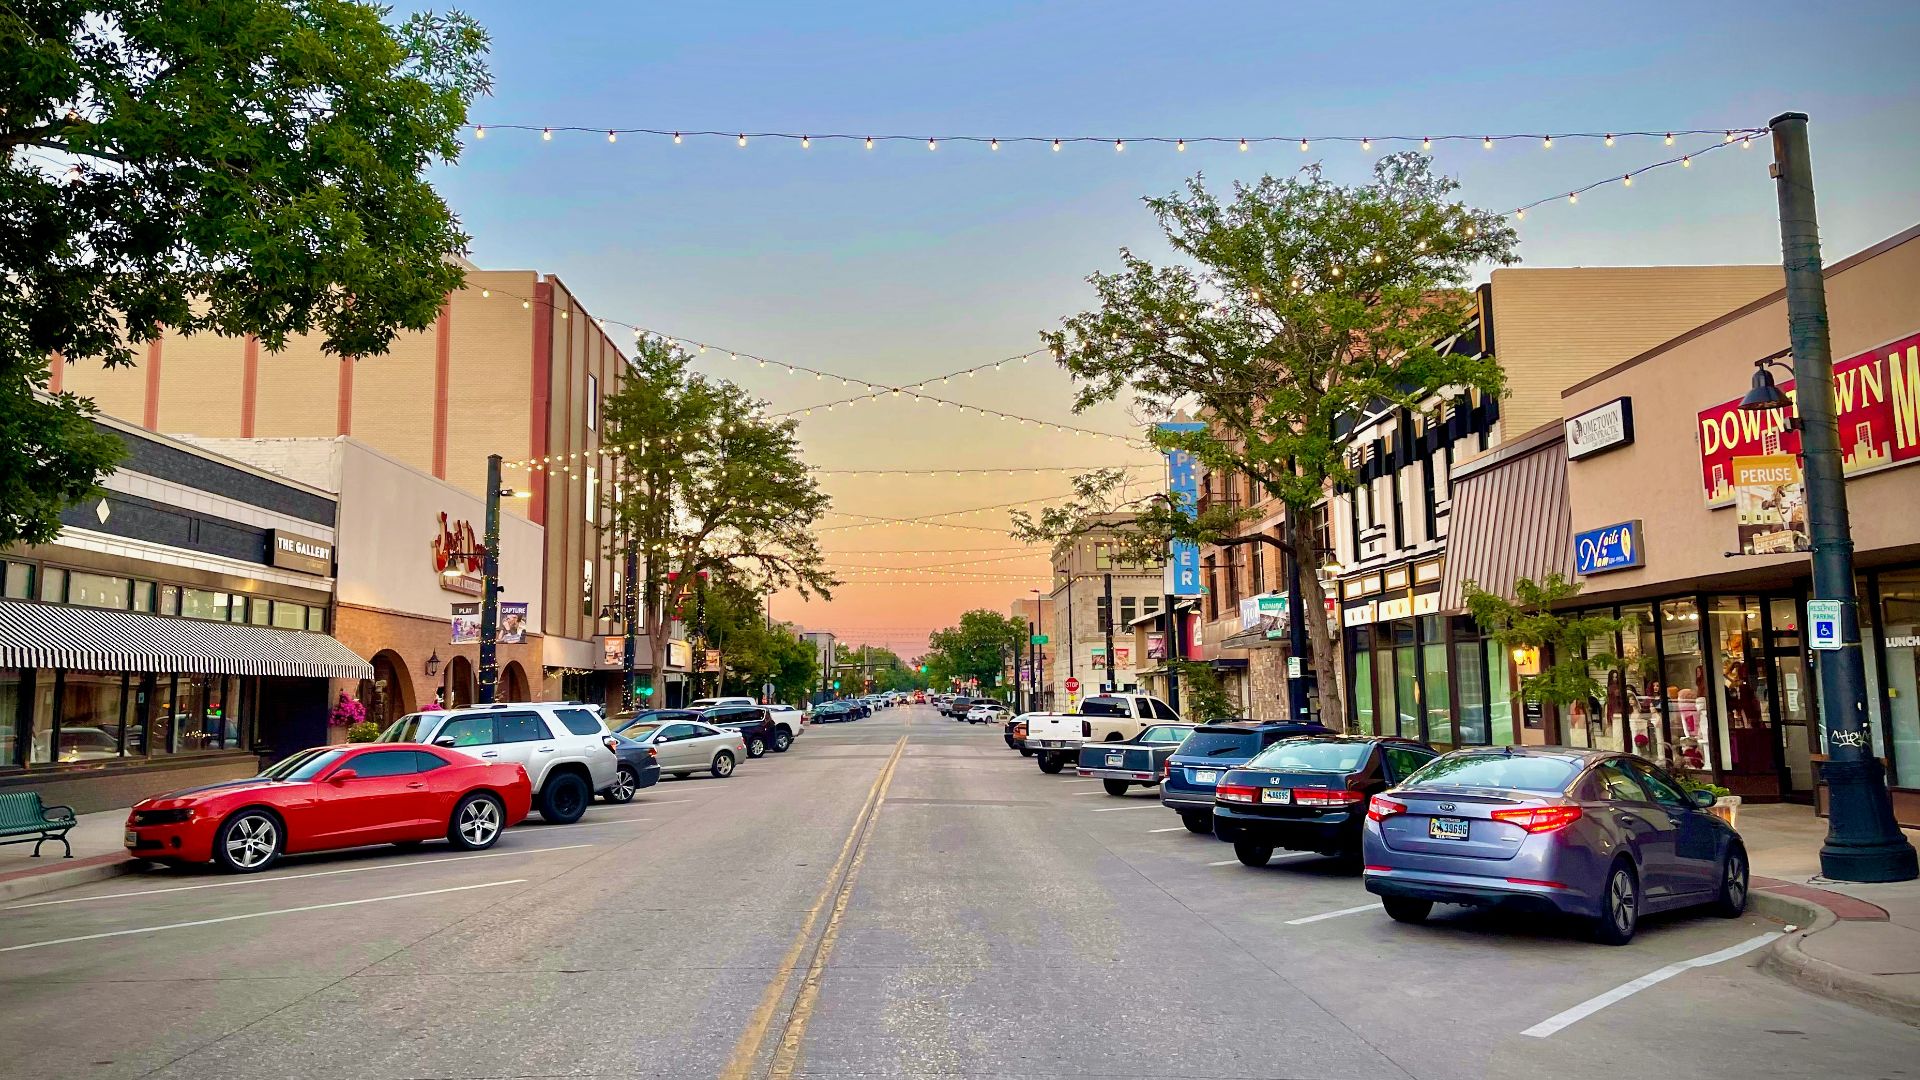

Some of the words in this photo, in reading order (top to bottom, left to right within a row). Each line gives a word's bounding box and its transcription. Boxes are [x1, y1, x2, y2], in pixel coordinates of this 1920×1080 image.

[1702, 359, 1884, 456] DOWNTWN
[1741, 467, 1792, 483] PERUSE
[1177, 453, 1192, 586] PIOER
[278, 537, 294, 551] THE
[295, 541, 329, 559] GALLERY
[1885, 636, 1920, 647] LUNCH
